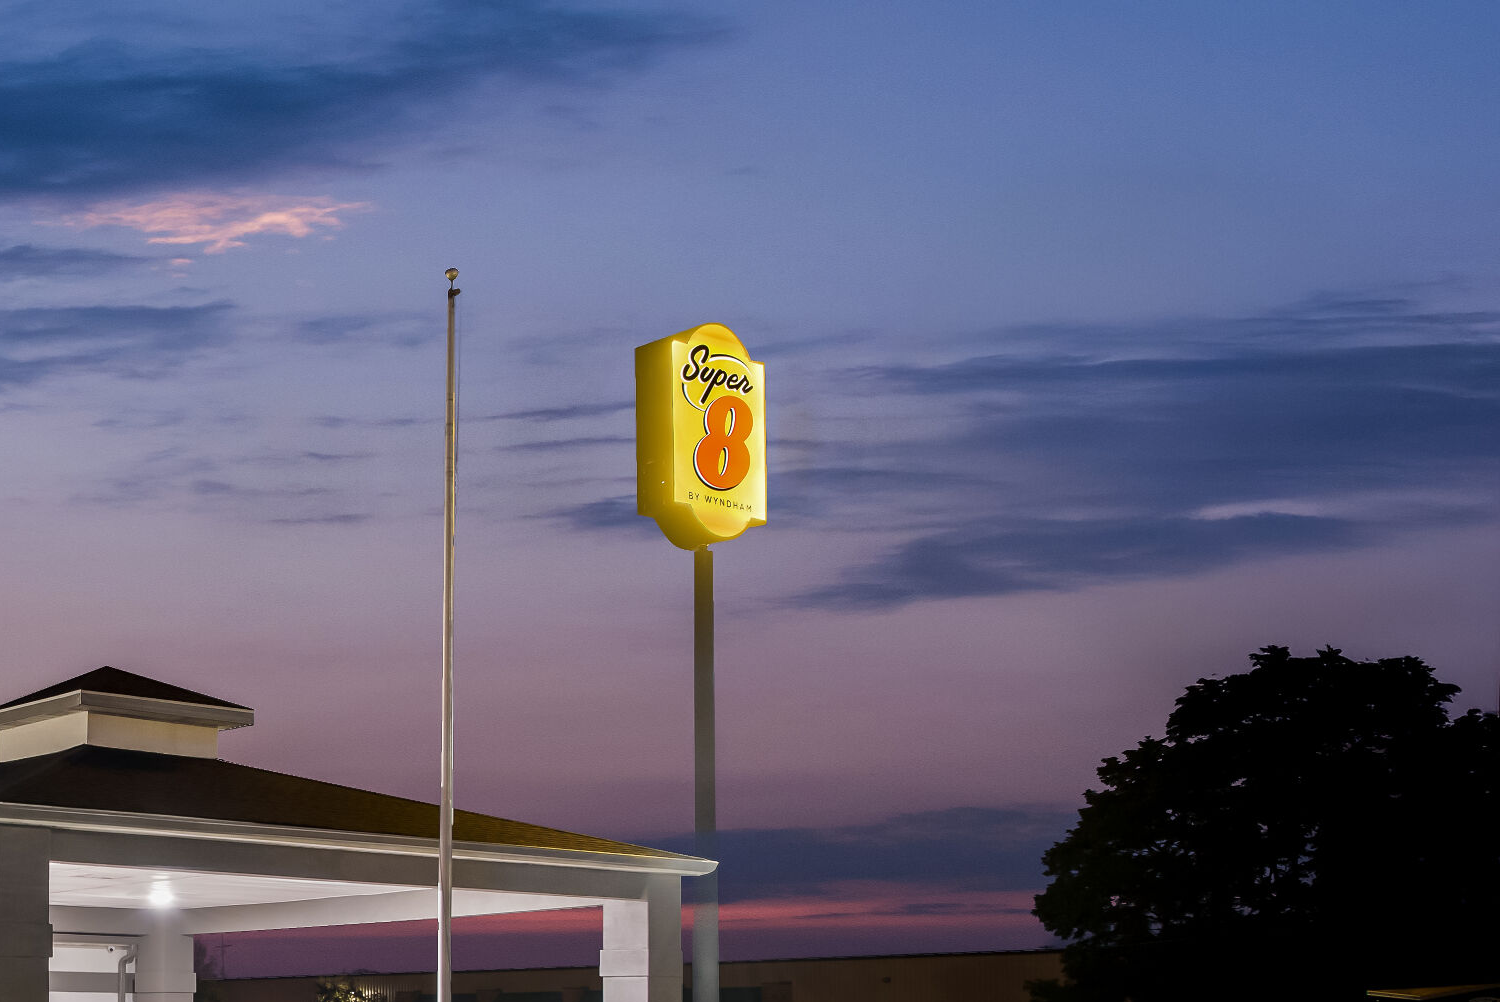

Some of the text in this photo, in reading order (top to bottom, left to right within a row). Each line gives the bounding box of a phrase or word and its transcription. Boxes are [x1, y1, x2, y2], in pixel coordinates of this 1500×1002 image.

[681, 344, 753, 405] Super
[693, 395, 754, 491] 8
[688, 491, 752, 513] BY WYNDHAM
